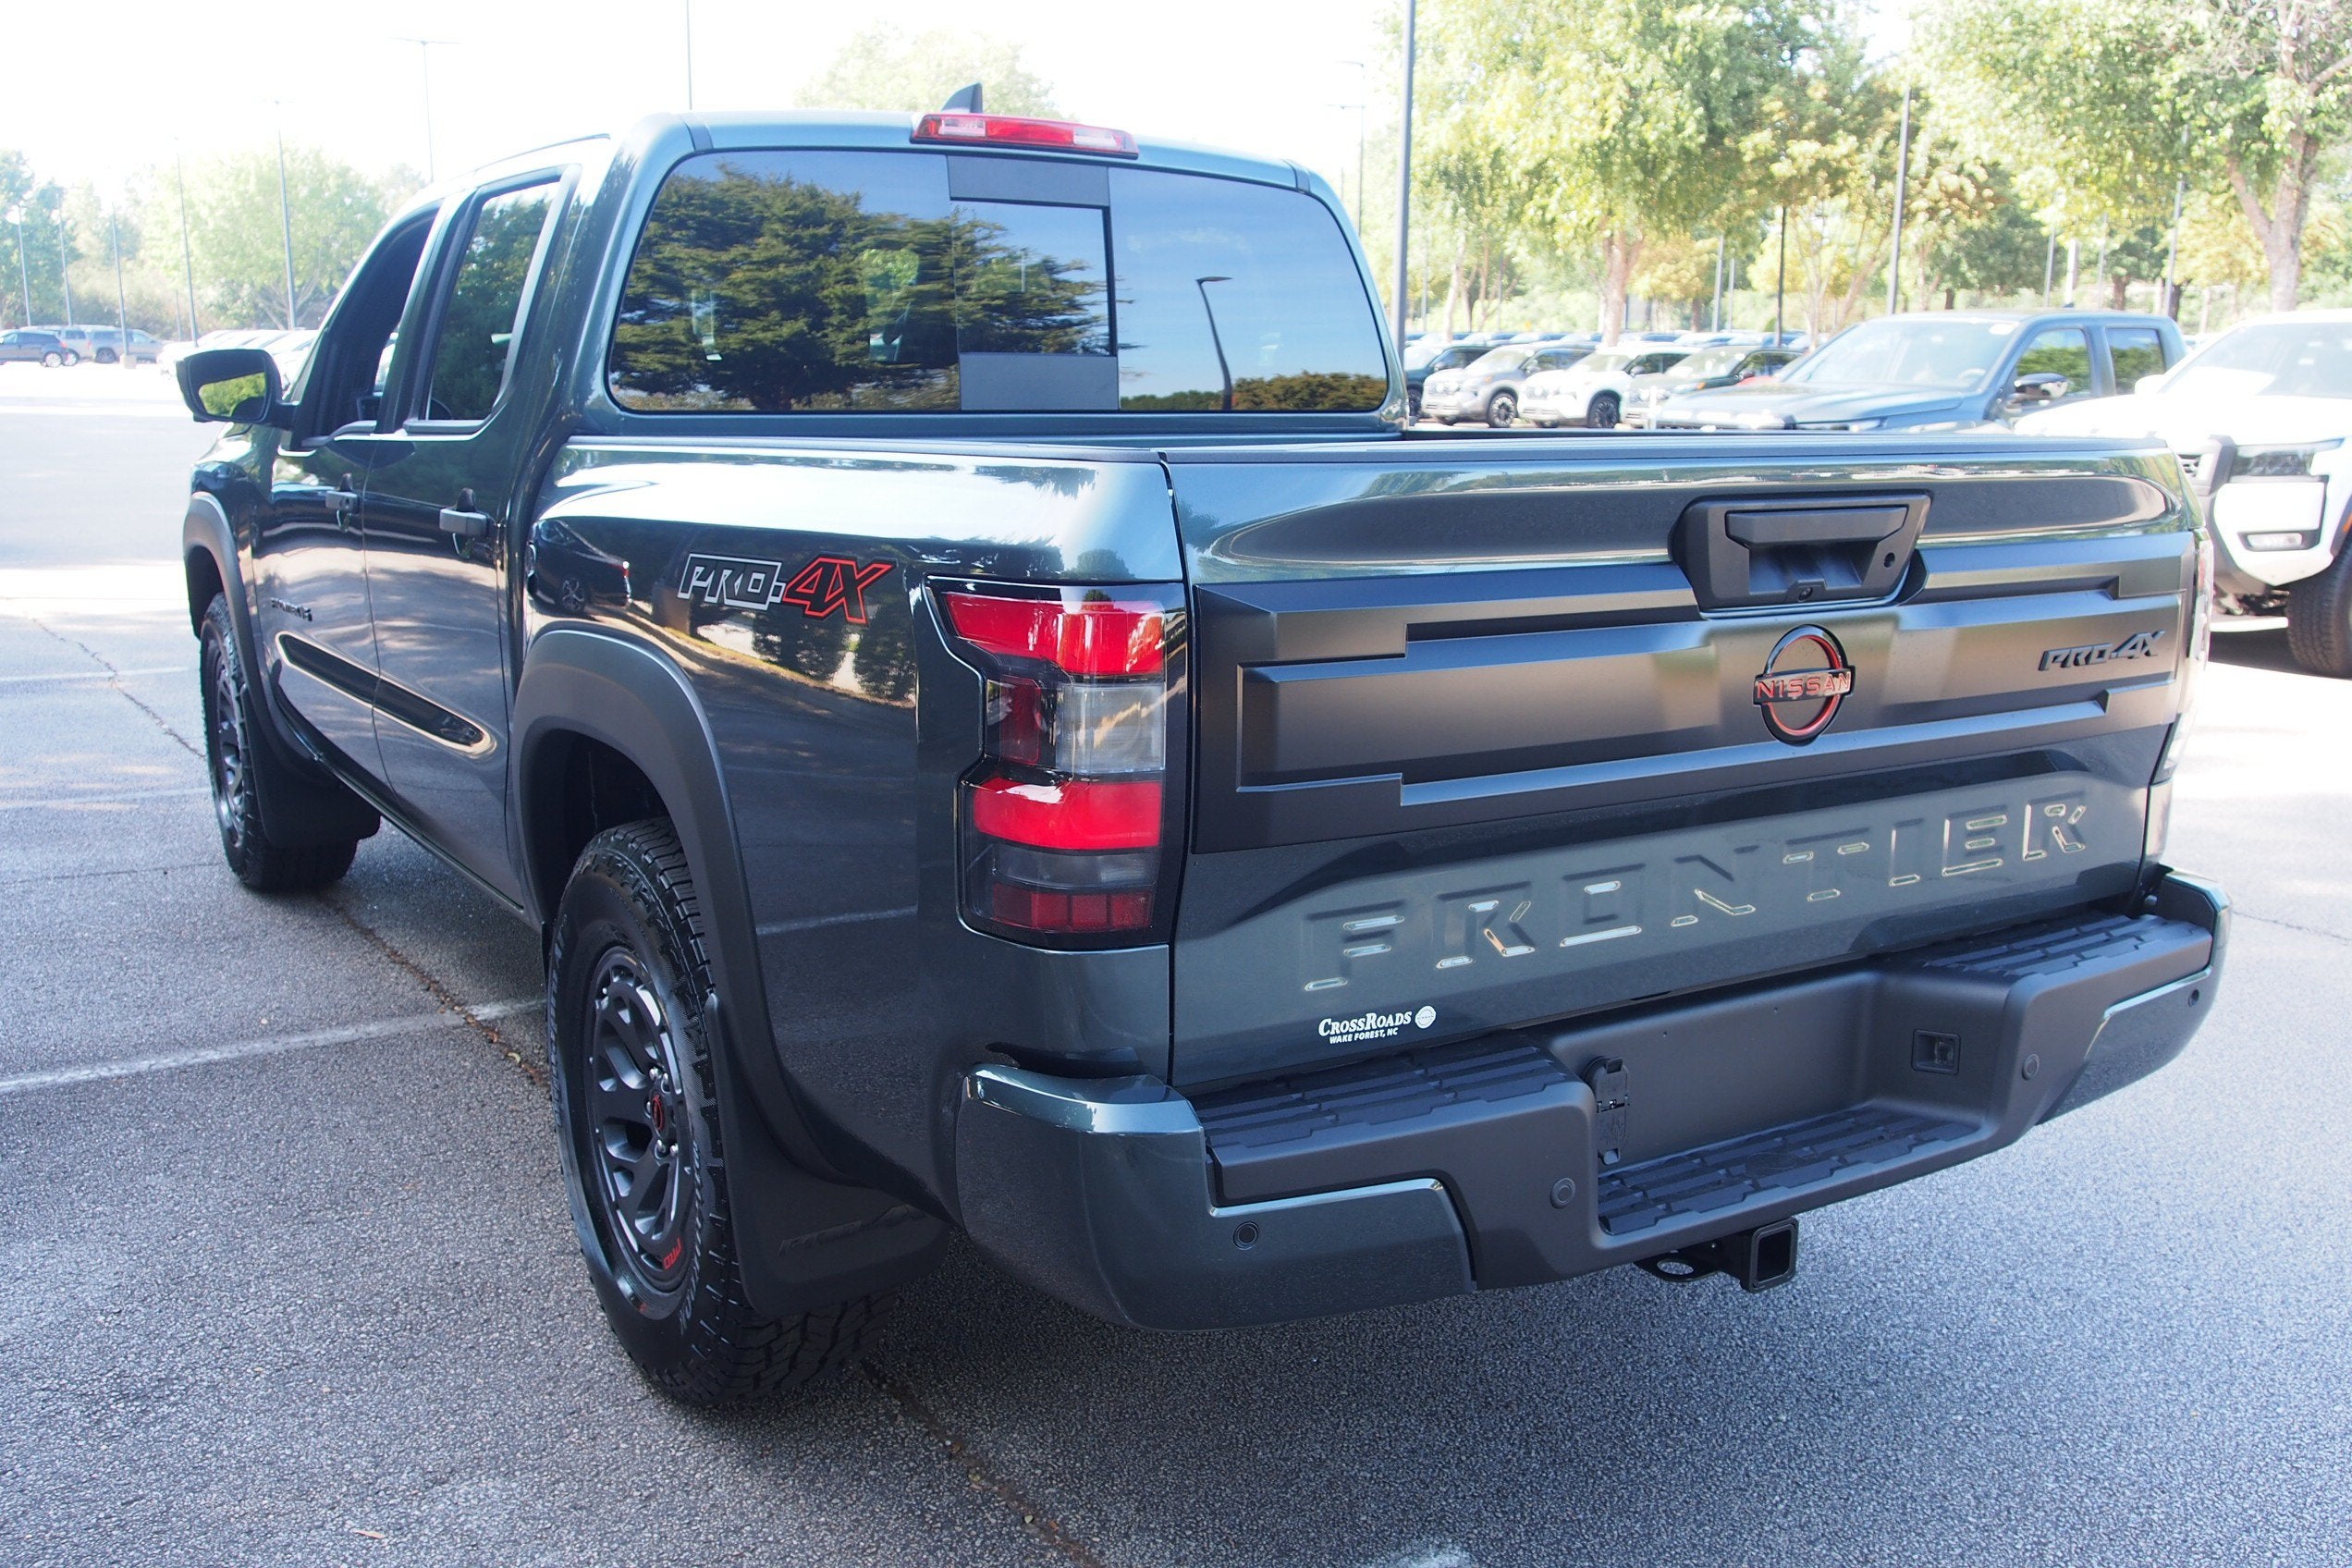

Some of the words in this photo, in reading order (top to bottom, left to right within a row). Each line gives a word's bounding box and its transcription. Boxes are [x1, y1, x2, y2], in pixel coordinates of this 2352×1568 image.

[1756, 670, 1852, 700] NISSAN
[1302, 788, 2088, 993] FRONTIER
[1329, 1035, 1352, 1045] WAKE
[1354, 1029, 1386, 1041] FOREST,
[1387, 1027, 1399, 1036] NC
